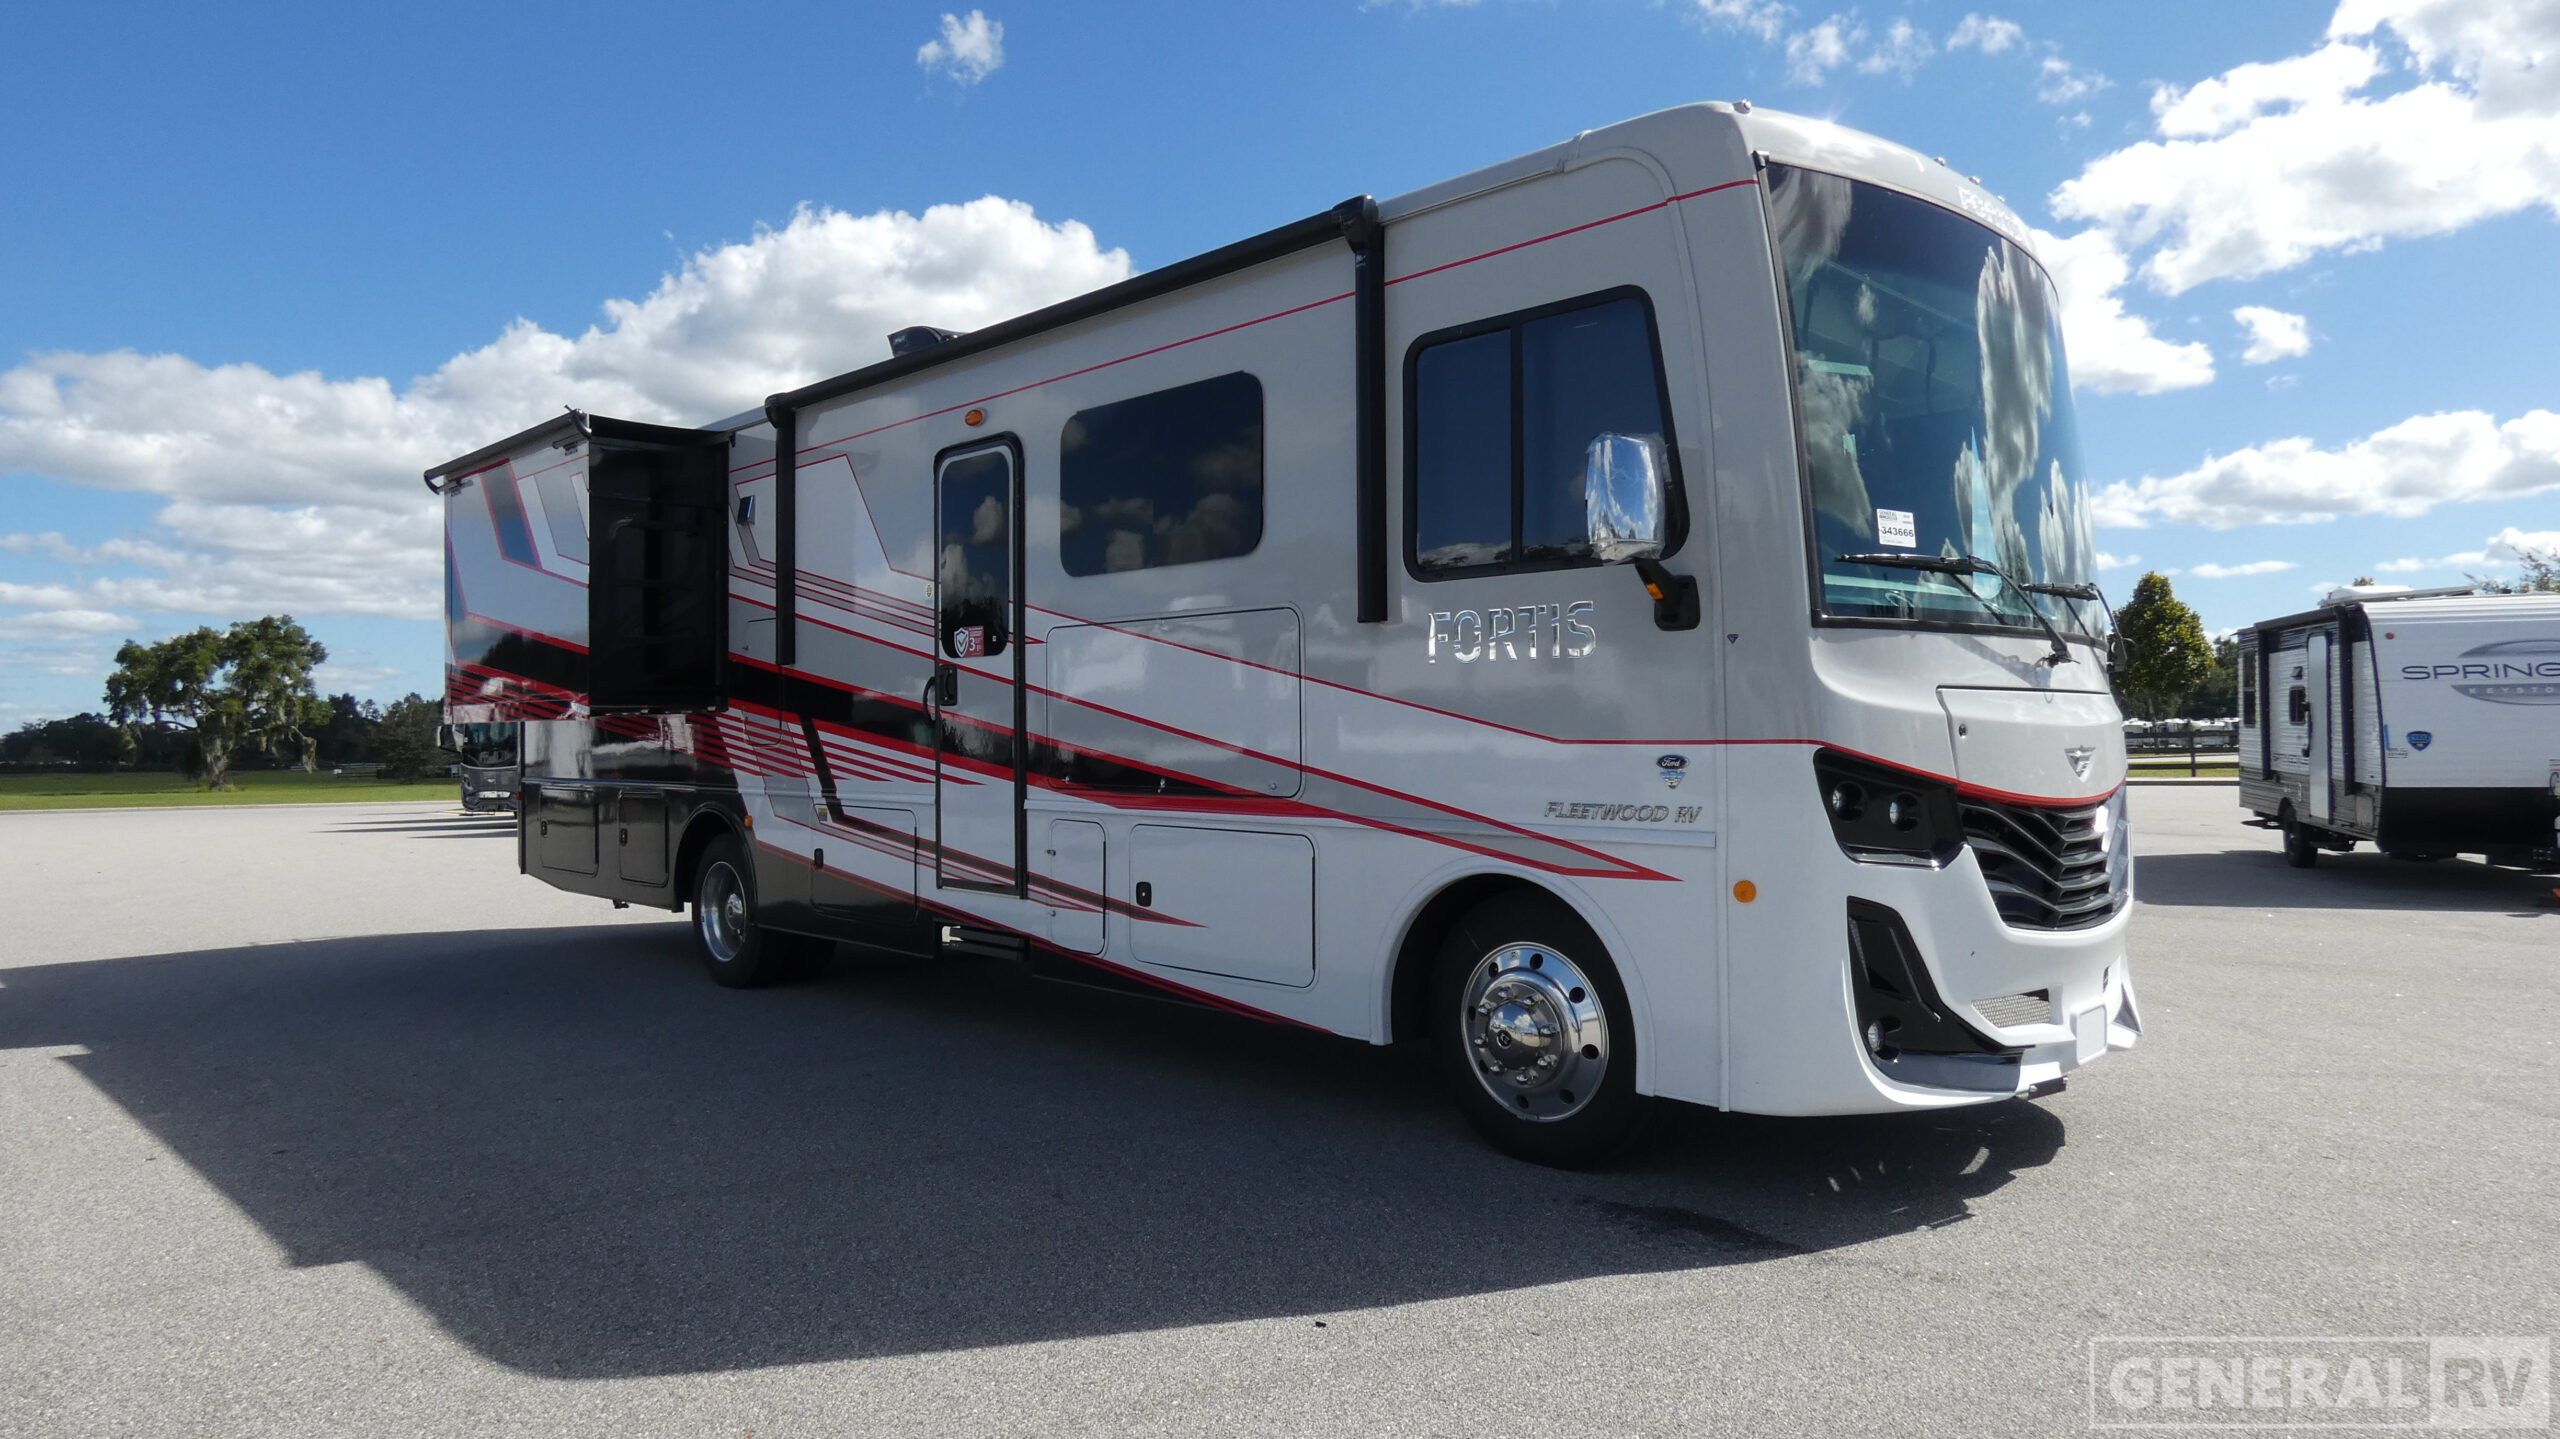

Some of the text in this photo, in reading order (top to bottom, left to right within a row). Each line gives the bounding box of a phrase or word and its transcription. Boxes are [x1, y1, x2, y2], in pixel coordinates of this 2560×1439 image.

[1881, 526, 1914, 537] 343666
[1428, 600, 1596, 663] FORTIS
[969, 637, 975, 651] 3
[2401, 662, 2560, 680] SPRING
[1544, 801, 1703, 824] FLEETWOOD RV
